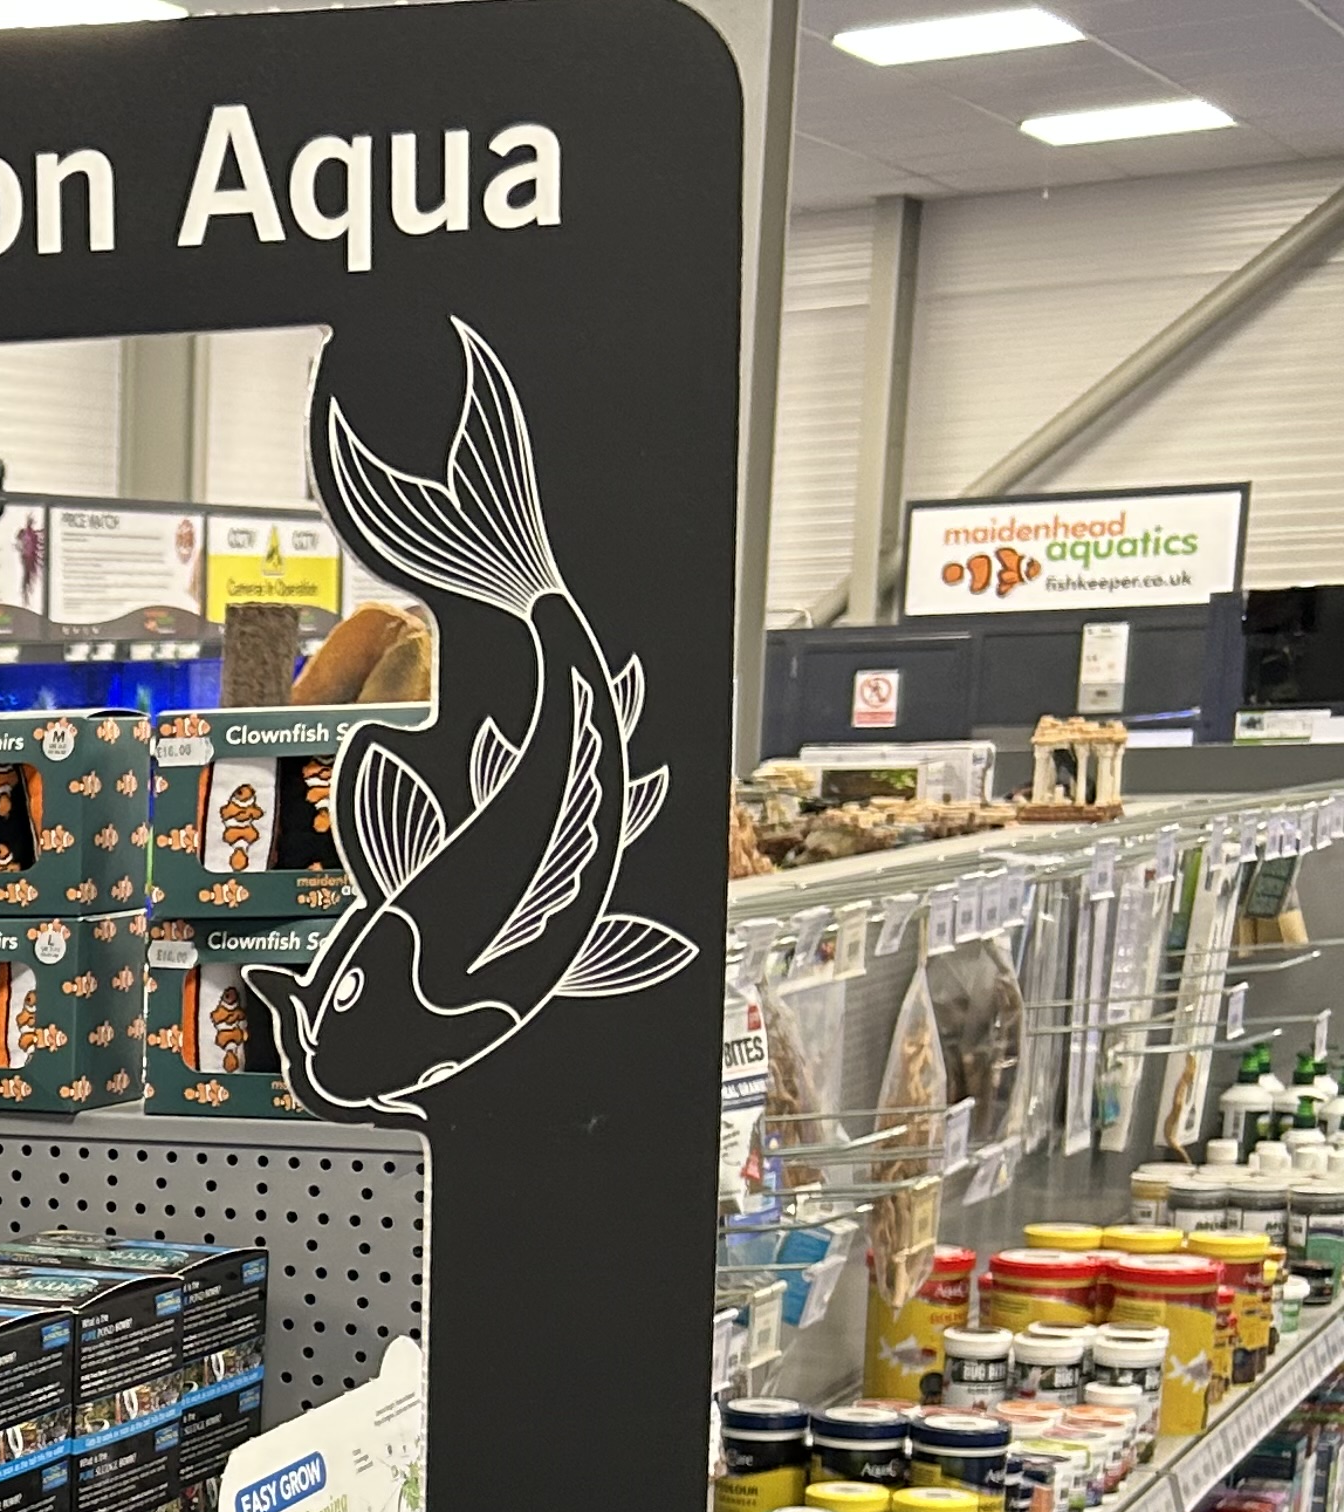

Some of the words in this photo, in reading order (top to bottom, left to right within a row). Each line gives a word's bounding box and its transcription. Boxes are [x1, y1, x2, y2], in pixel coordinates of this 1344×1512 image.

[177, 103, 563, 273] Aqua
[943, 509, 1127, 545] maidenhead
[1045, 525, 1199, 569] aquatics
[1045, 570, 1192, 593] fishkeeper.co.uk
[52, 730, 66, 743] M
[226, 723, 330, 745] Clownfish
[207, 930, 300, 951] Clownfish
[723, 1034, 765, 1066] BITES
[279, 1458, 322, 1501] GROW
